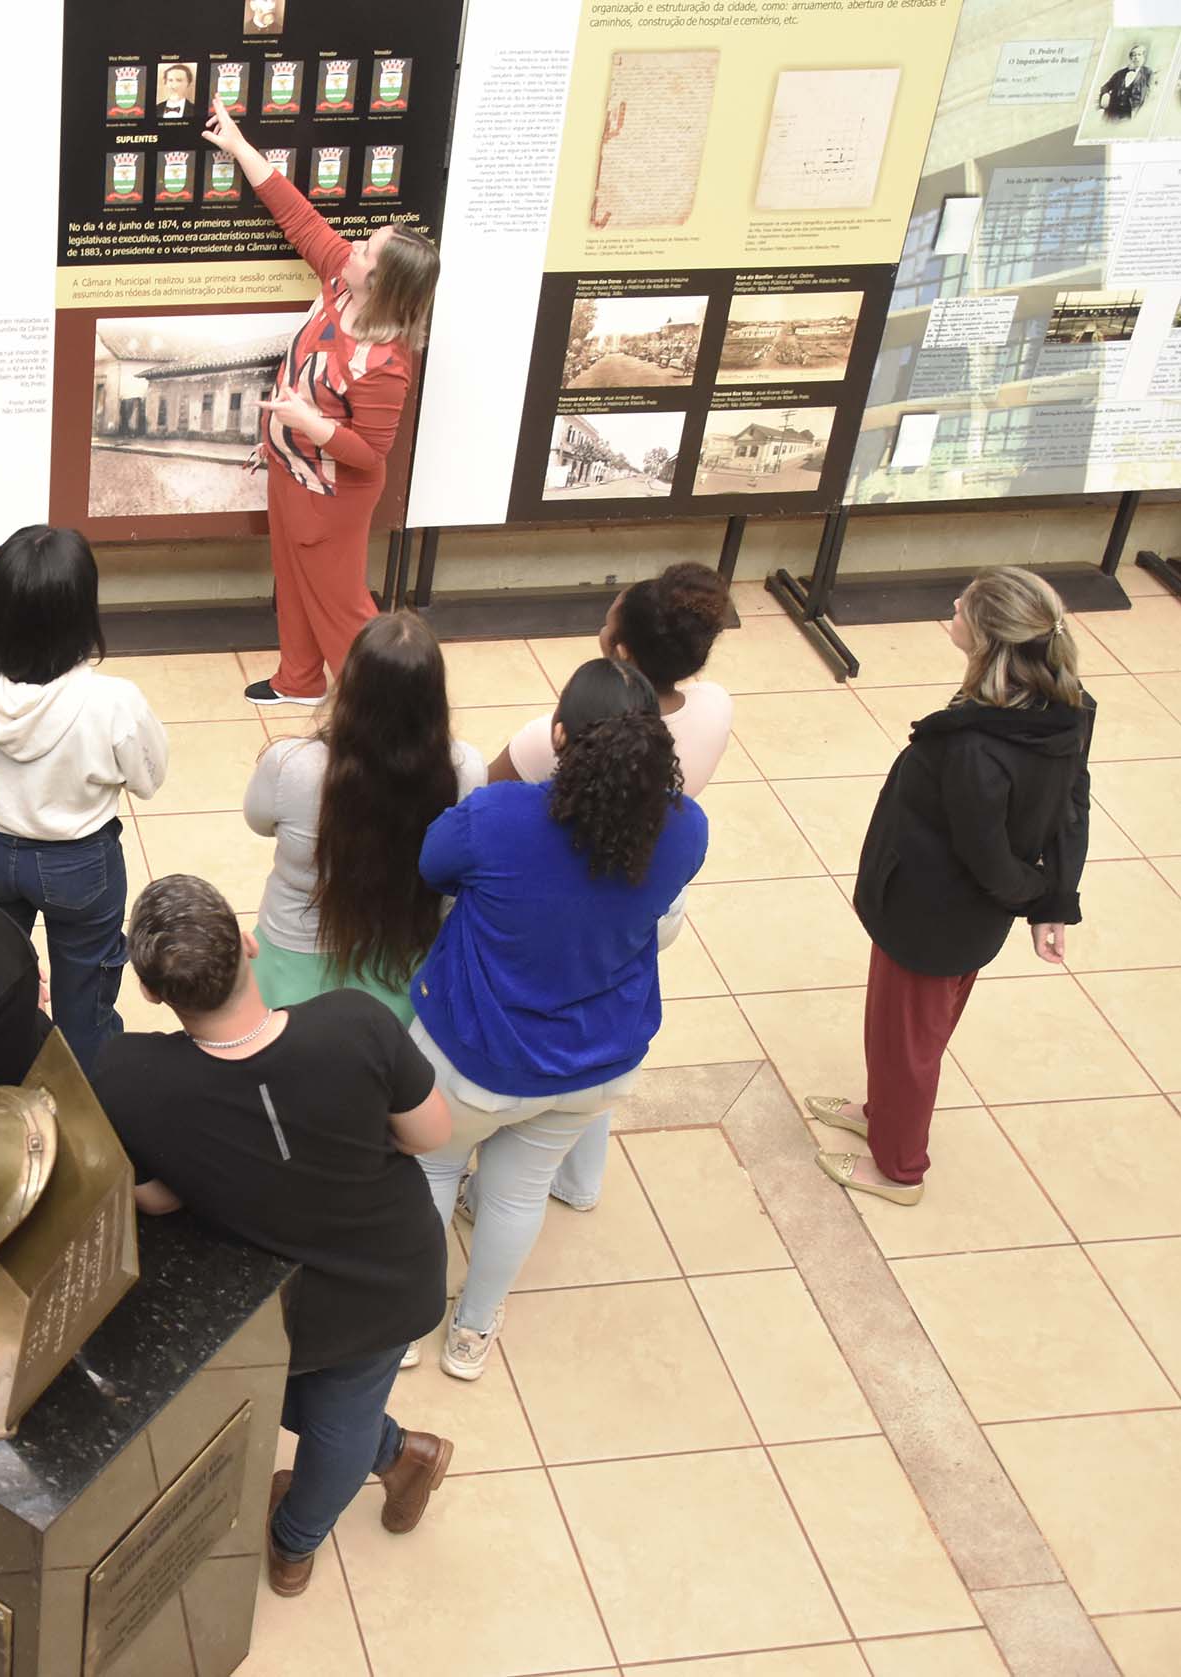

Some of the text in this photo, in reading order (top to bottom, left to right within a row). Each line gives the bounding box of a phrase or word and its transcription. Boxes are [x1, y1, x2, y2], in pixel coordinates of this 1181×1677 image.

[116, 135, 157, 144] SUPLENTES
[69, 222, 80, 232] No
[83, 221, 95, 231] dia
[97, 221, 103, 231] 4
[105, 221, 116, 231] de
[118, 220, 142, 232] junho
[144, 220, 155, 230] de
[158, 219, 179, 231] 1874,
[194, 217, 230, 230] primeiros
